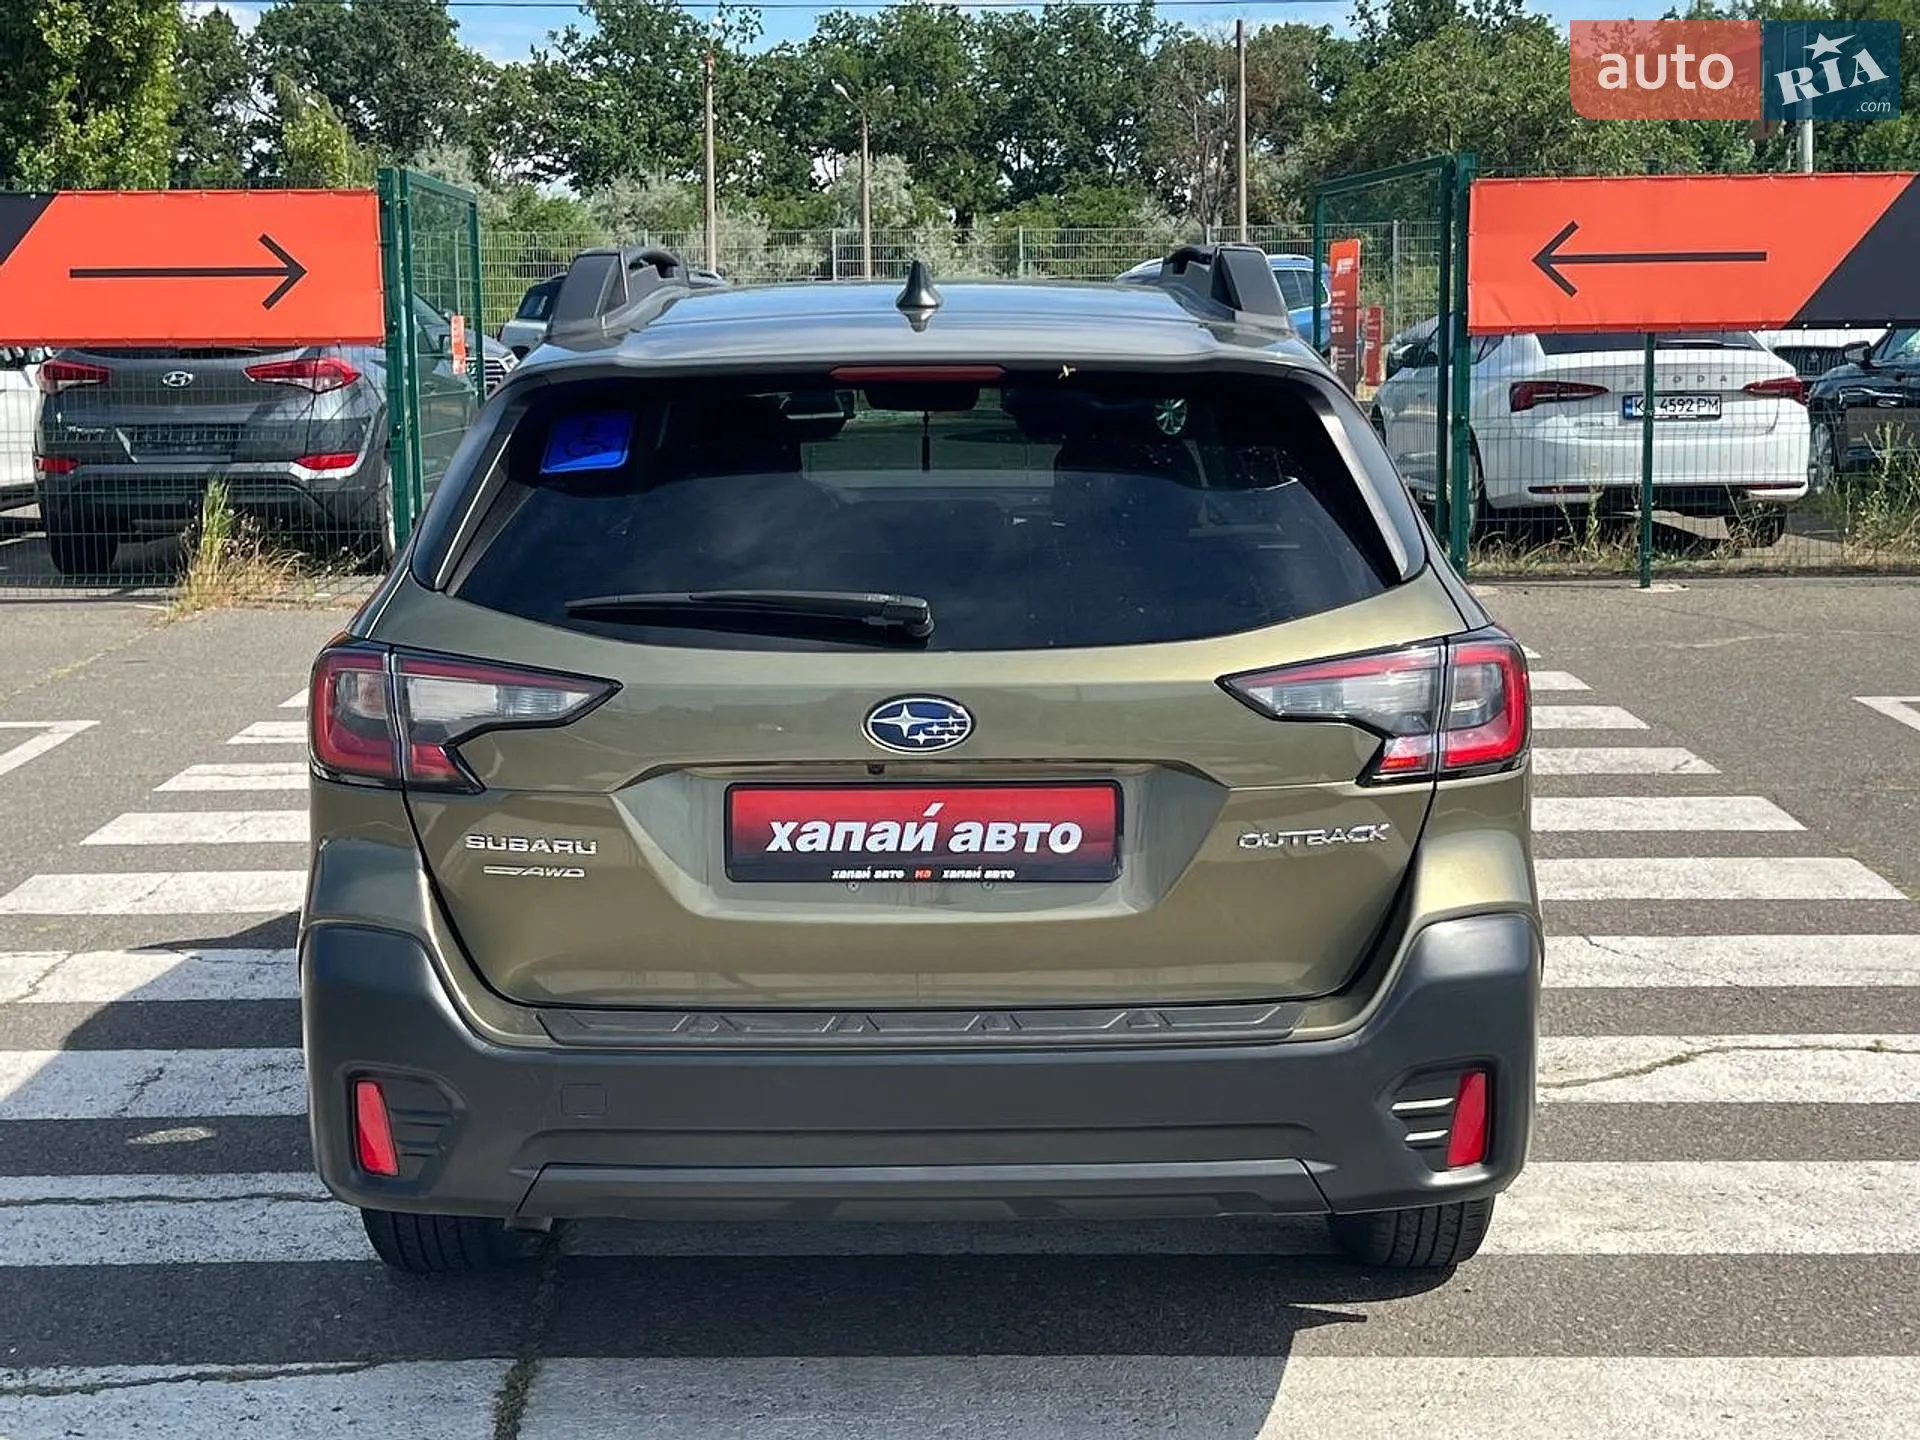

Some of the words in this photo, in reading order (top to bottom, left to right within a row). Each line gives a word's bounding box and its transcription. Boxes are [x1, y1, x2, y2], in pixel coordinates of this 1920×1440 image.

[1660, 397, 1694, 412] 4592
[765, 802, 944, 853] хапай
[947, 820, 1084, 854] авто
[1238, 823, 1391, 849] OUTBACK
[465, 835, 597, 855] SUBARU
[520, 866, 585, 878] AWD
